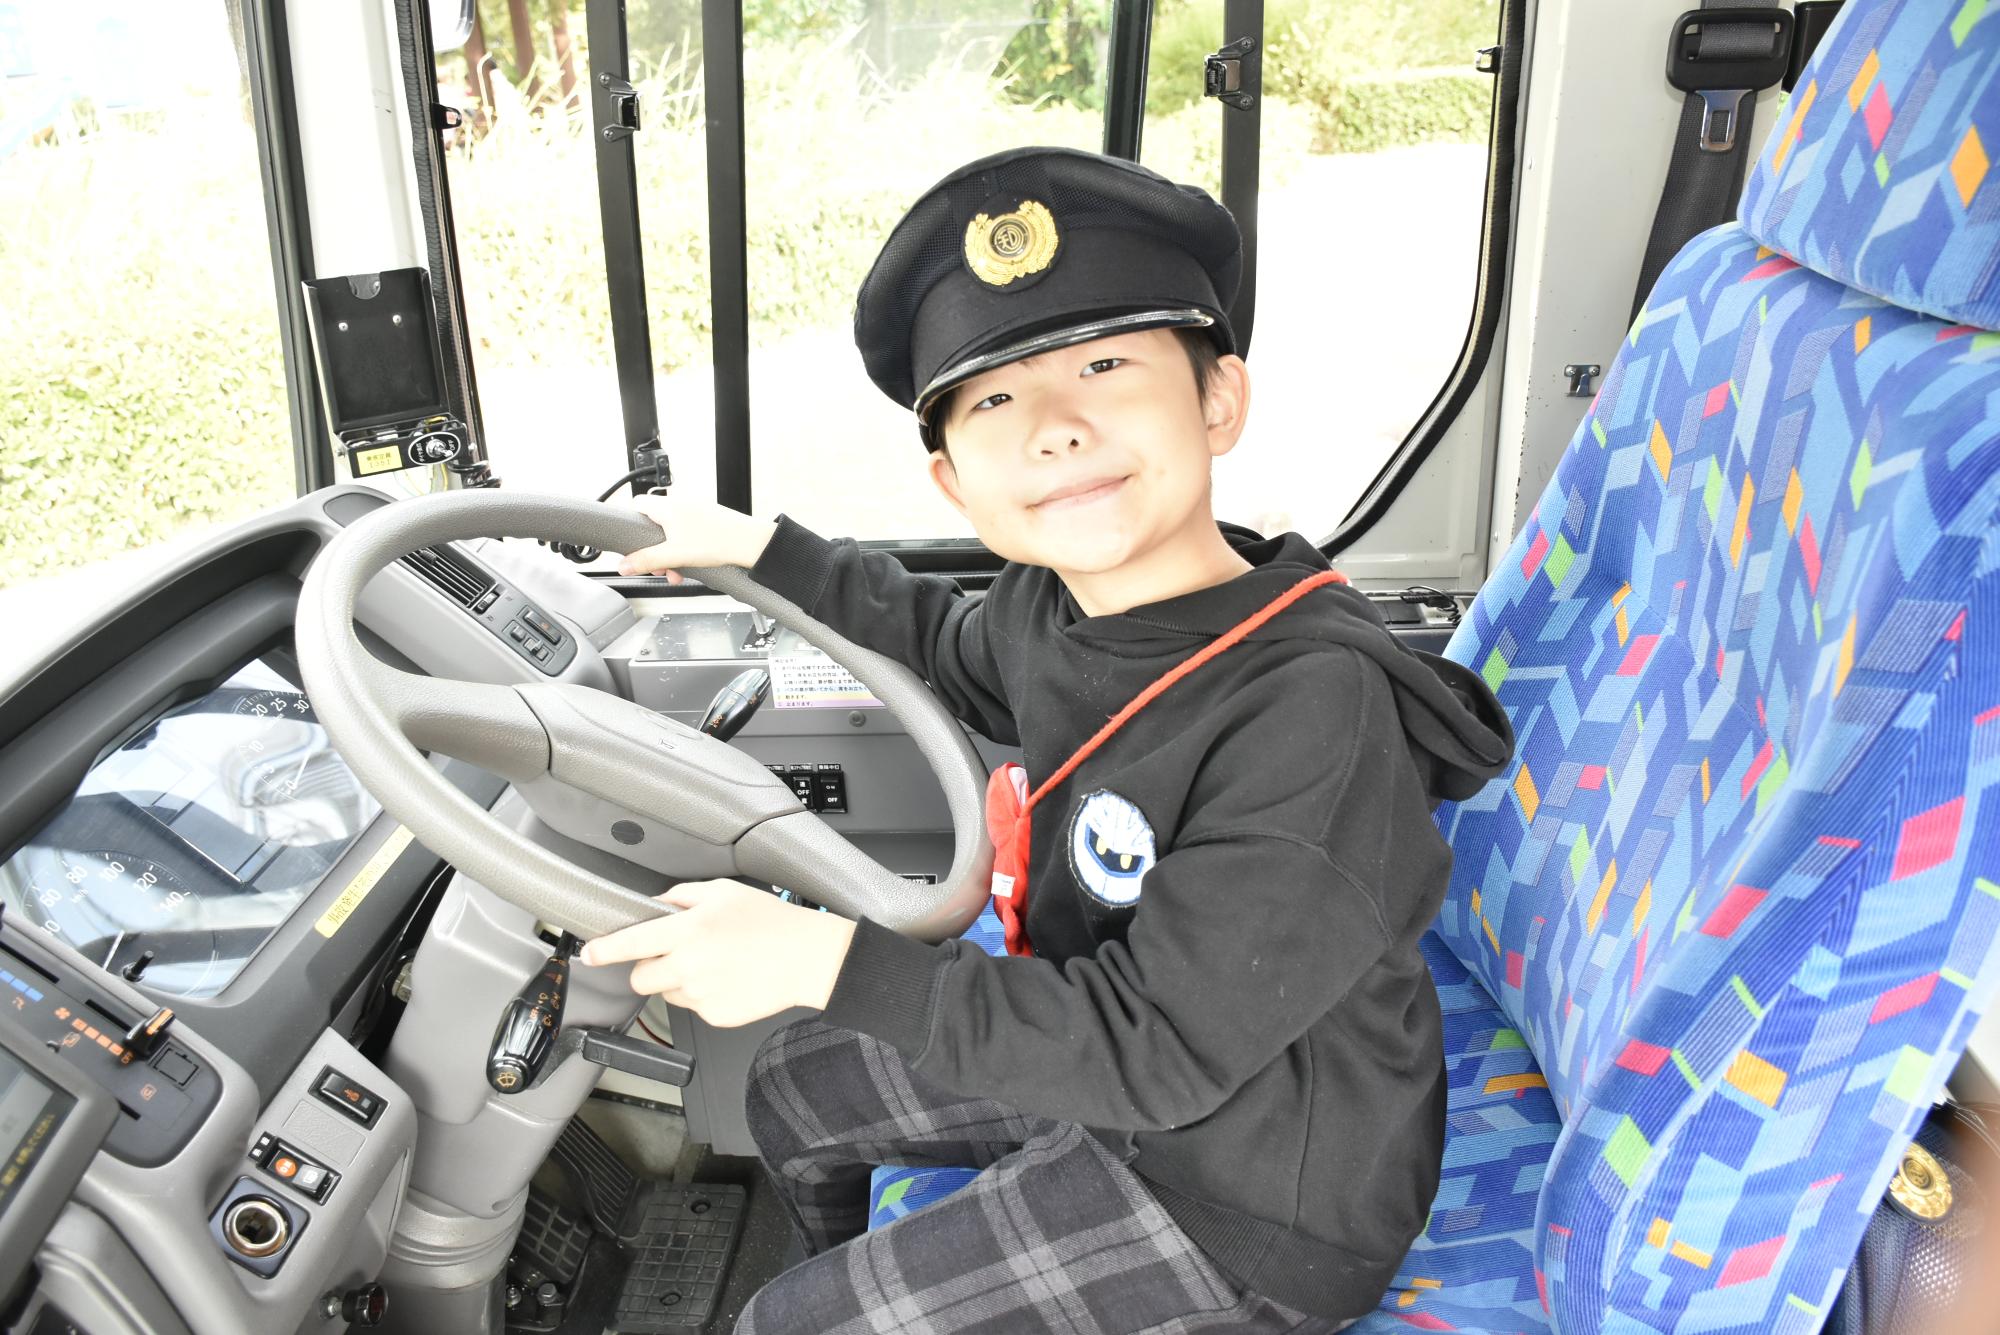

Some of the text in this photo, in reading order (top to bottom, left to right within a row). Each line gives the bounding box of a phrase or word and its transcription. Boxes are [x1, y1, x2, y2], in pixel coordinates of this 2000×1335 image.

[251, 698, 310, 718] 20 25 30
[66, 861, 185, 912] 80 100 120 140
[39, 888, 63, 908] 60
